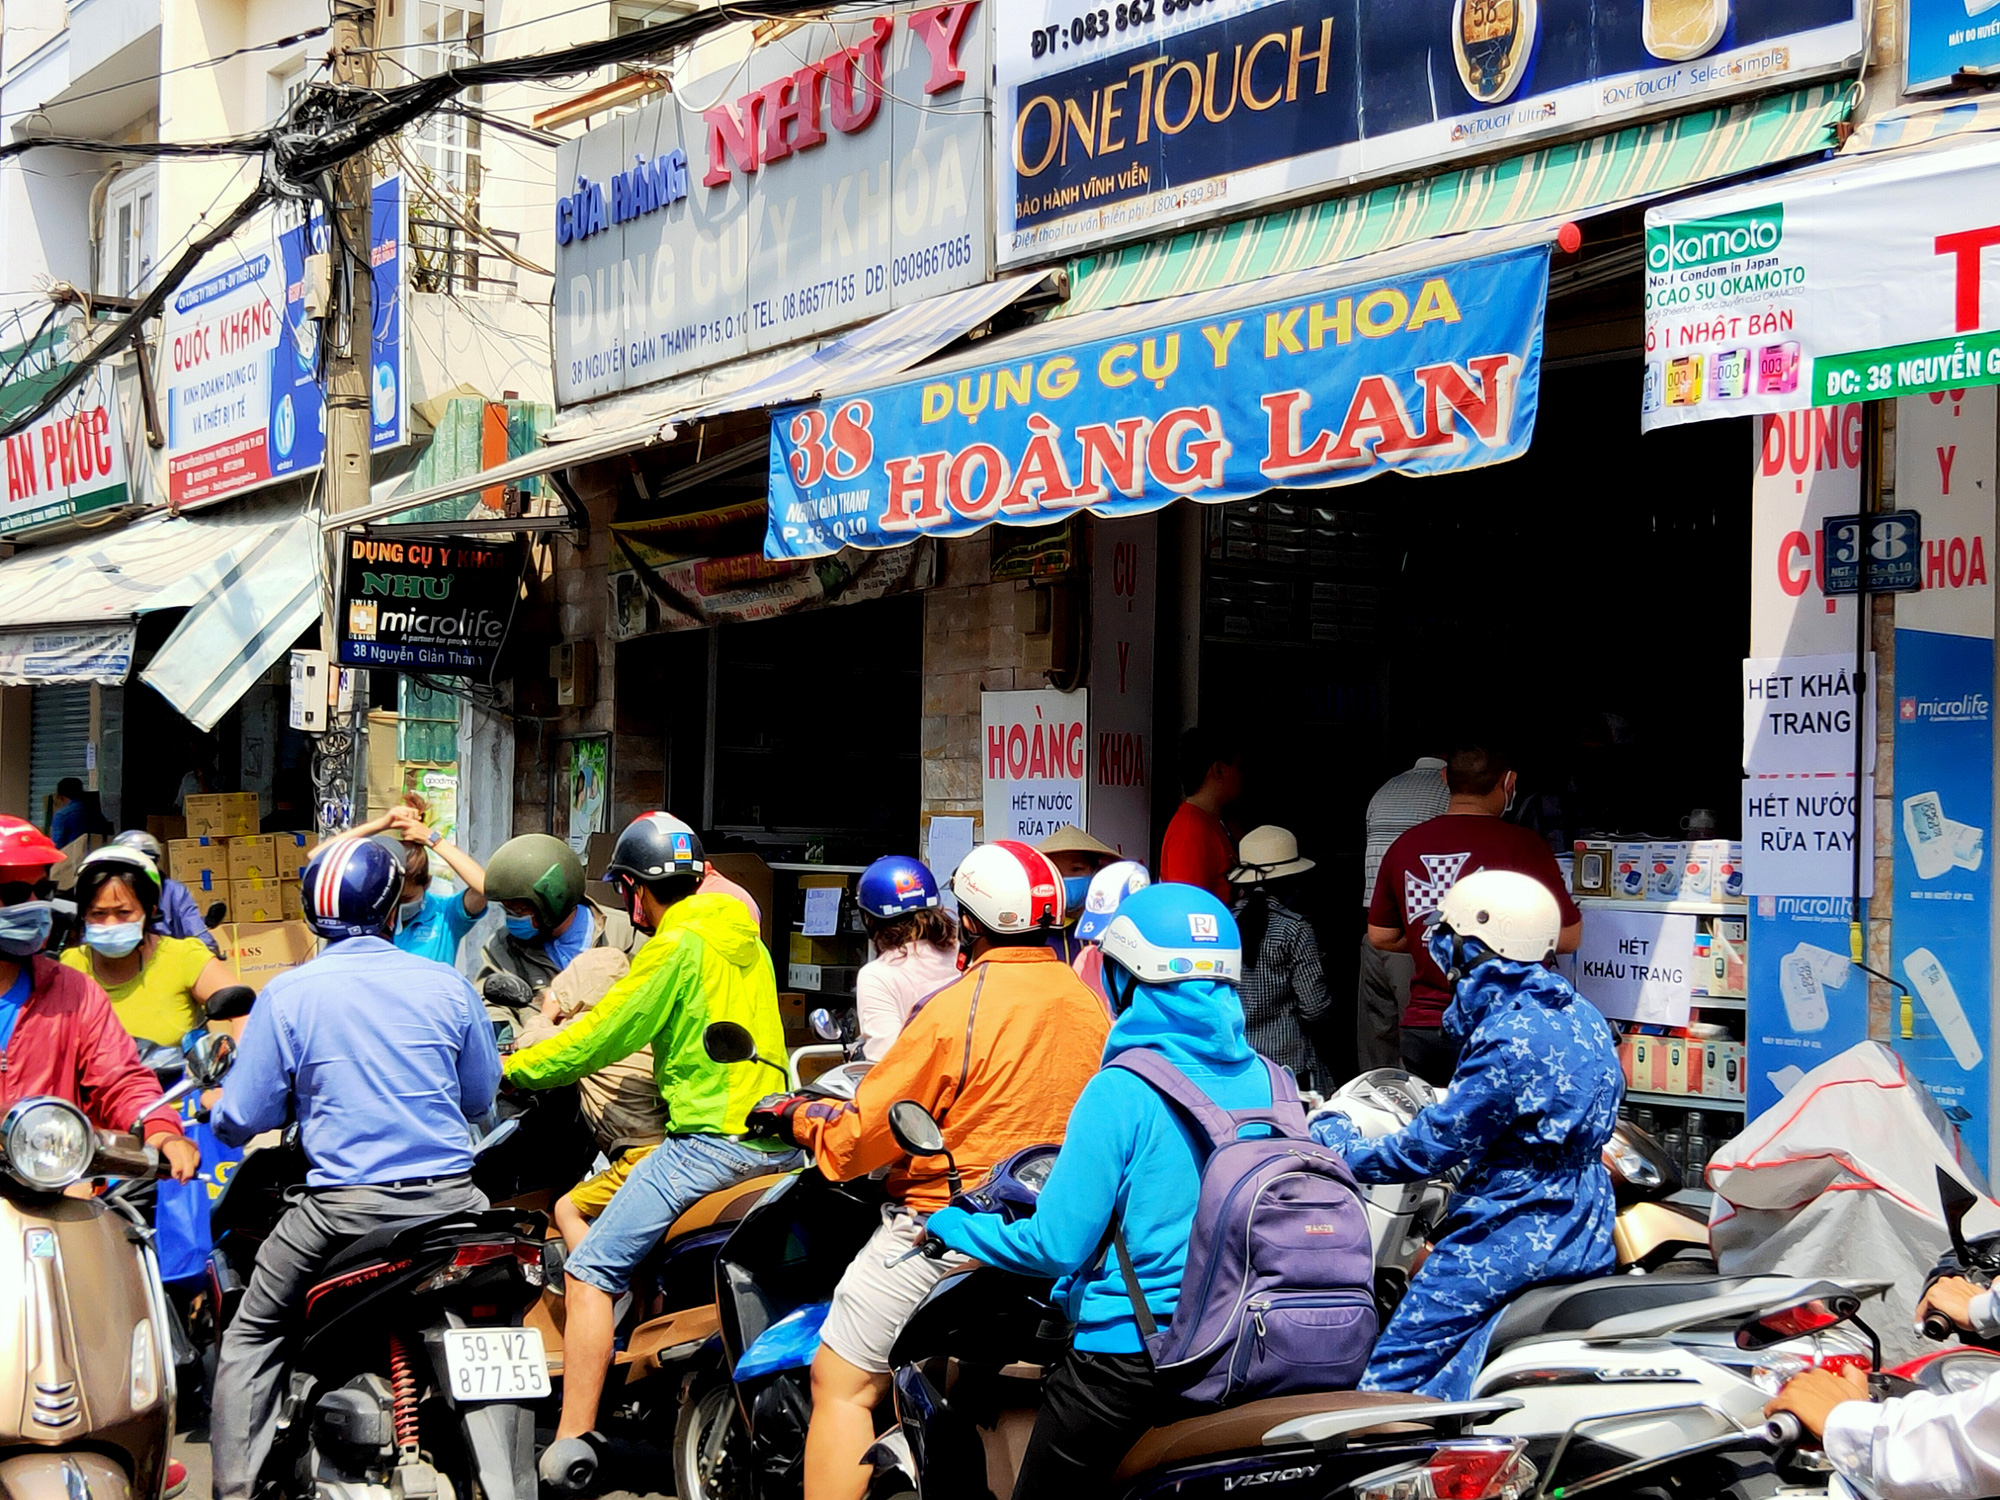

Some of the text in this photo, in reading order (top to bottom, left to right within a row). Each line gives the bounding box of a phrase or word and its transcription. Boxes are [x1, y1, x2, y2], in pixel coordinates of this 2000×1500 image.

[1690, 64, 1731, 85] Select
[1735, 50, 1783, 74] Simple
[703, 15, 893, 188] NHƯ
[556, 147, 688, 247] CỬA HÀNG
[821, 135, 967, 264] KHOA
[1016, 161, 1149, 219] BẢO HÀNH VĨNH VIỄN
[1649, 219, 1777, 271] okamoto
[1657, 286, 1690, 307] CAO
[1695, 281, 1715, 301] SU
[1721, 265, 1805, 296] OKAMOTO
[1680, 264, 1727, 283] Condom
[1731, 261, 1741, 273] in
[1745, 257, 1779, 271] Japan
[572, 361, 583, 385] 38
[585, 339, 625, 382] NGUYỄN
[660, 324, 697, 359] THANH
[753, 300, 778, 331] TEL:
[782, 274, 856, 322] 08.66577155
[892, 234, 972, 288] 0909667865
[1680, 314, 1742, 346] NHẬT
[1749, 304, 1793, 336] BẢN
[174, 299, 271, 372] QUỐC KHANG
[922, 278, 1461, 427] DỤNG CỤ Y KHOA
[1761, 358, 1782, 374] 003
[1827, 369, 1861, 396] ĐC:
[1866, 364, 1892, 391] 38
[1898, 341, 1981, 387] NGUYỄN
[183, 388, 199, 406] KINH
[201, 375, 225, 400] DOANH
[788, 398, 876, 489] 38
[879, 353, 1523, 533] HOÀNG LAN
[1762, 402, 1862, 494] DỤNG
[6, 433, 37, 502] AN
[1936, 445, 1957, 495] Y
[839, 489, 870, 514] THANH
[352, 540, 403, 564] DỤNG
[408, 545, 433, 569] CỤ
[440, 547, 451, 567] Y
[1836, 521, 1908, 563] 38
[1113, 541, 1137, 613] CỤ
[1919, 536, 1988, 592] HOA
[361, 572, 456, 600] NHƯ
[380, 606, 503, 638] microlife
[353, 644, 366, 657] 38
[1117, 642, 1130, 694] Y
[1749, 672, 1793, 699] HẾT
[1917, 694, 1989, 716] microlife
[988, 705, 1084, 780] HOÀNG
[1769, 710, 1851, 735] TRANG
[1098, 732, 1145, 787] KHOA
[1012, 791, 1073, 810] HẾT NƯỚC
[1749, 792, 1790, 817] HẾT
[1813, 831, 1855, 851] TAY
[1619, 936, 1650, 955] HẾT
[1630, 965, 1683, 983] TRANG
[462, 1335, 529, 1362] 59-V2
[459, 1364, 542, 1393] 877.55
[1223, 1464, 1322, 1491] VISION
